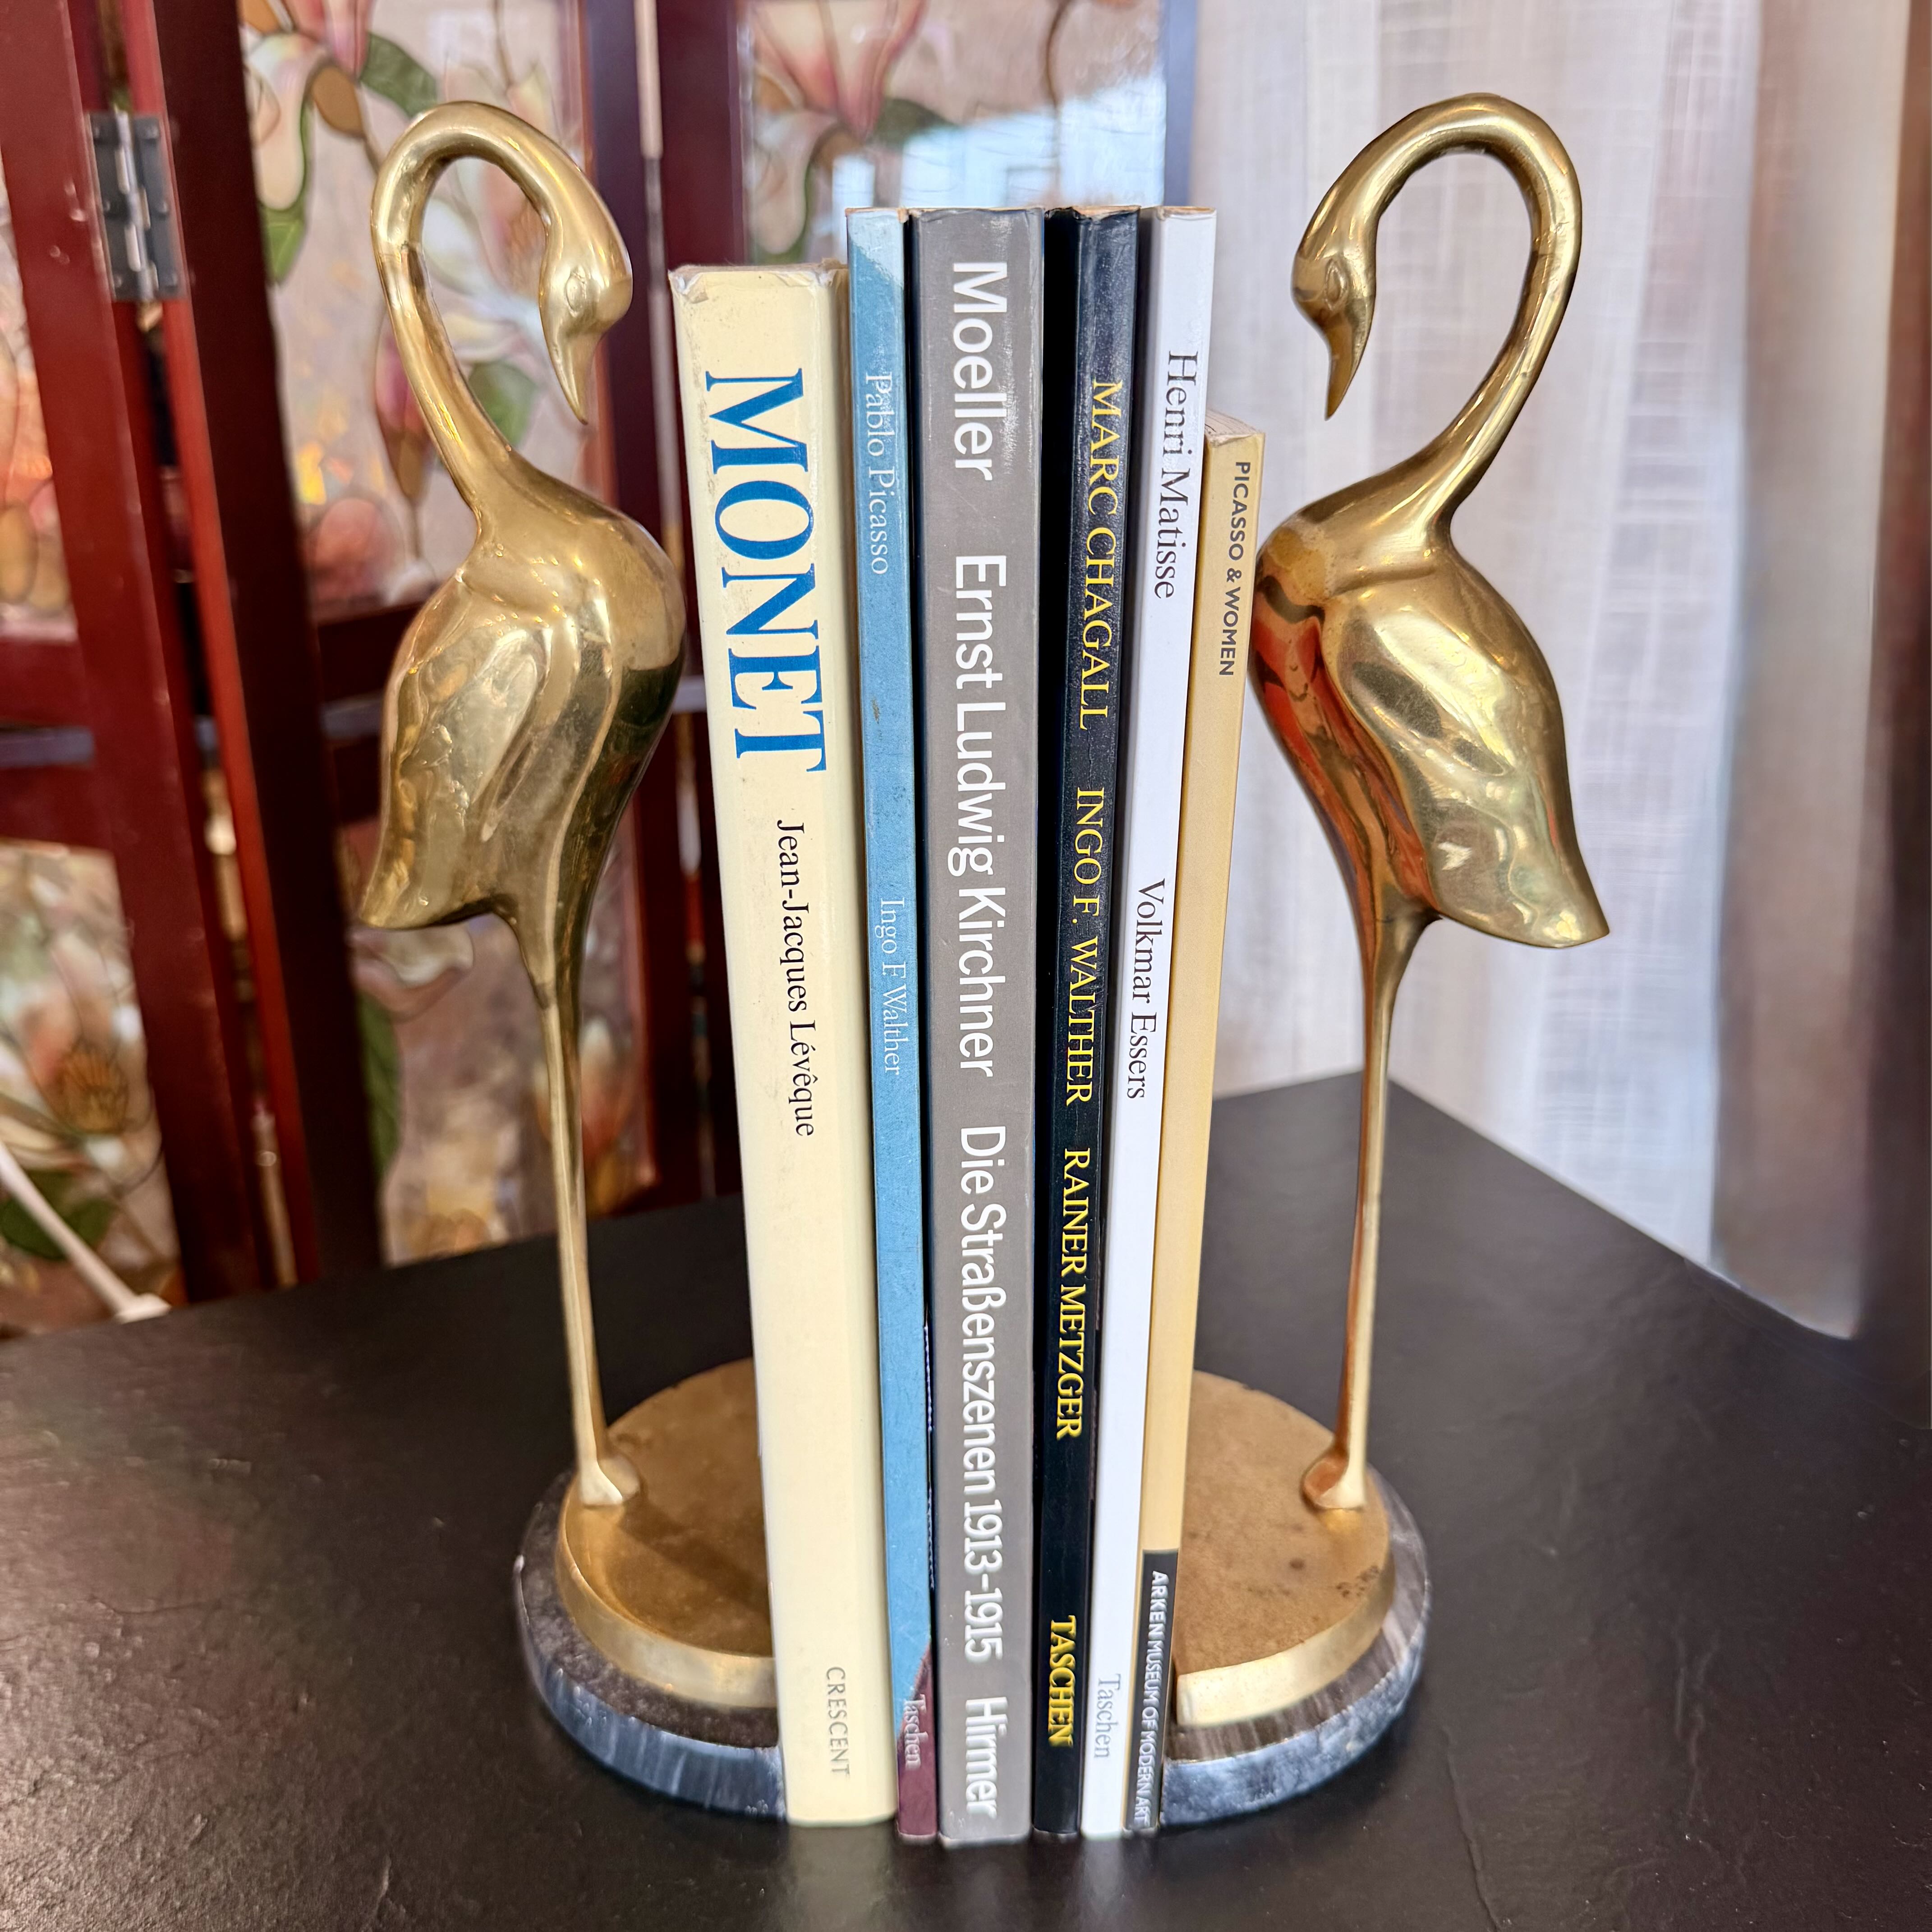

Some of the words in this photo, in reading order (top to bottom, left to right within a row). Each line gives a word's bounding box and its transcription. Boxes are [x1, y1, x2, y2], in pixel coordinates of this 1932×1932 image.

[865, 372, 895, 457] Pablo
[953, 262, 1007, 481] Moeller
[1164, 350, 1198, 457] Henri
[1087, 379, 1123, 516] MARC
[869, 466, 895, 575] Picasso
[1155, 468, 1191, 599] Matisse
[1229, 462, 1250, 561] PICASSO
[705, 368, 826, 772] MONET
[956, 556, 1006, 689] Ernst
[1228, 570, 1242, 582] &
[1080, 527, 1117, 730] CHAGALL
[1220, 587, 1242, 675] WOMEN
[948, 702, 1006, 876] Ludwig
[1073, 787, 1104, 884] INGO
[777, 819, 809, 1012] Jean-Jacques
[875, 897, 904, 954] Ingo
[1132, 879, 1165, 1003] Volkmar
[883, 984, 908, 1075] Walther
[958, 888, 1005, 1076] Kirchner
[1066, 936, 1098, 1106] WALTHER
[788, 1020, 818, 1136] Lévêque
[1127, 1012, 1157, 1099] Essers
[961, 1126, 1006, 1194] Die
[1062, 1148, 1090, 1277] RAINER
[961, 1204, 1006, 1495] Straßenszenen
[1057, 1284, 1086, 1440] METZGER
[964, 1500, 1003, 1663] 1913-1915
[1148, 1571, 1169, 1640] ARKEN
[826, 1666, 850, 1778] CRESCENT
[1048, 1615, 1076, 1748] TASCHEN
[1094, 1674, 1122, 1758] Taschen
[1141, 1707, 1159, 1731] OF
[1143, 1640, 1164, 1707] MUSEUM
[904, 1694, 928, 1770] Taschen
[966, 1697, 1008, 1819] Hirmer
[1136, 1731, 1157, 1797] MODERN
[1134, 1797, 1151, 1826] ART
